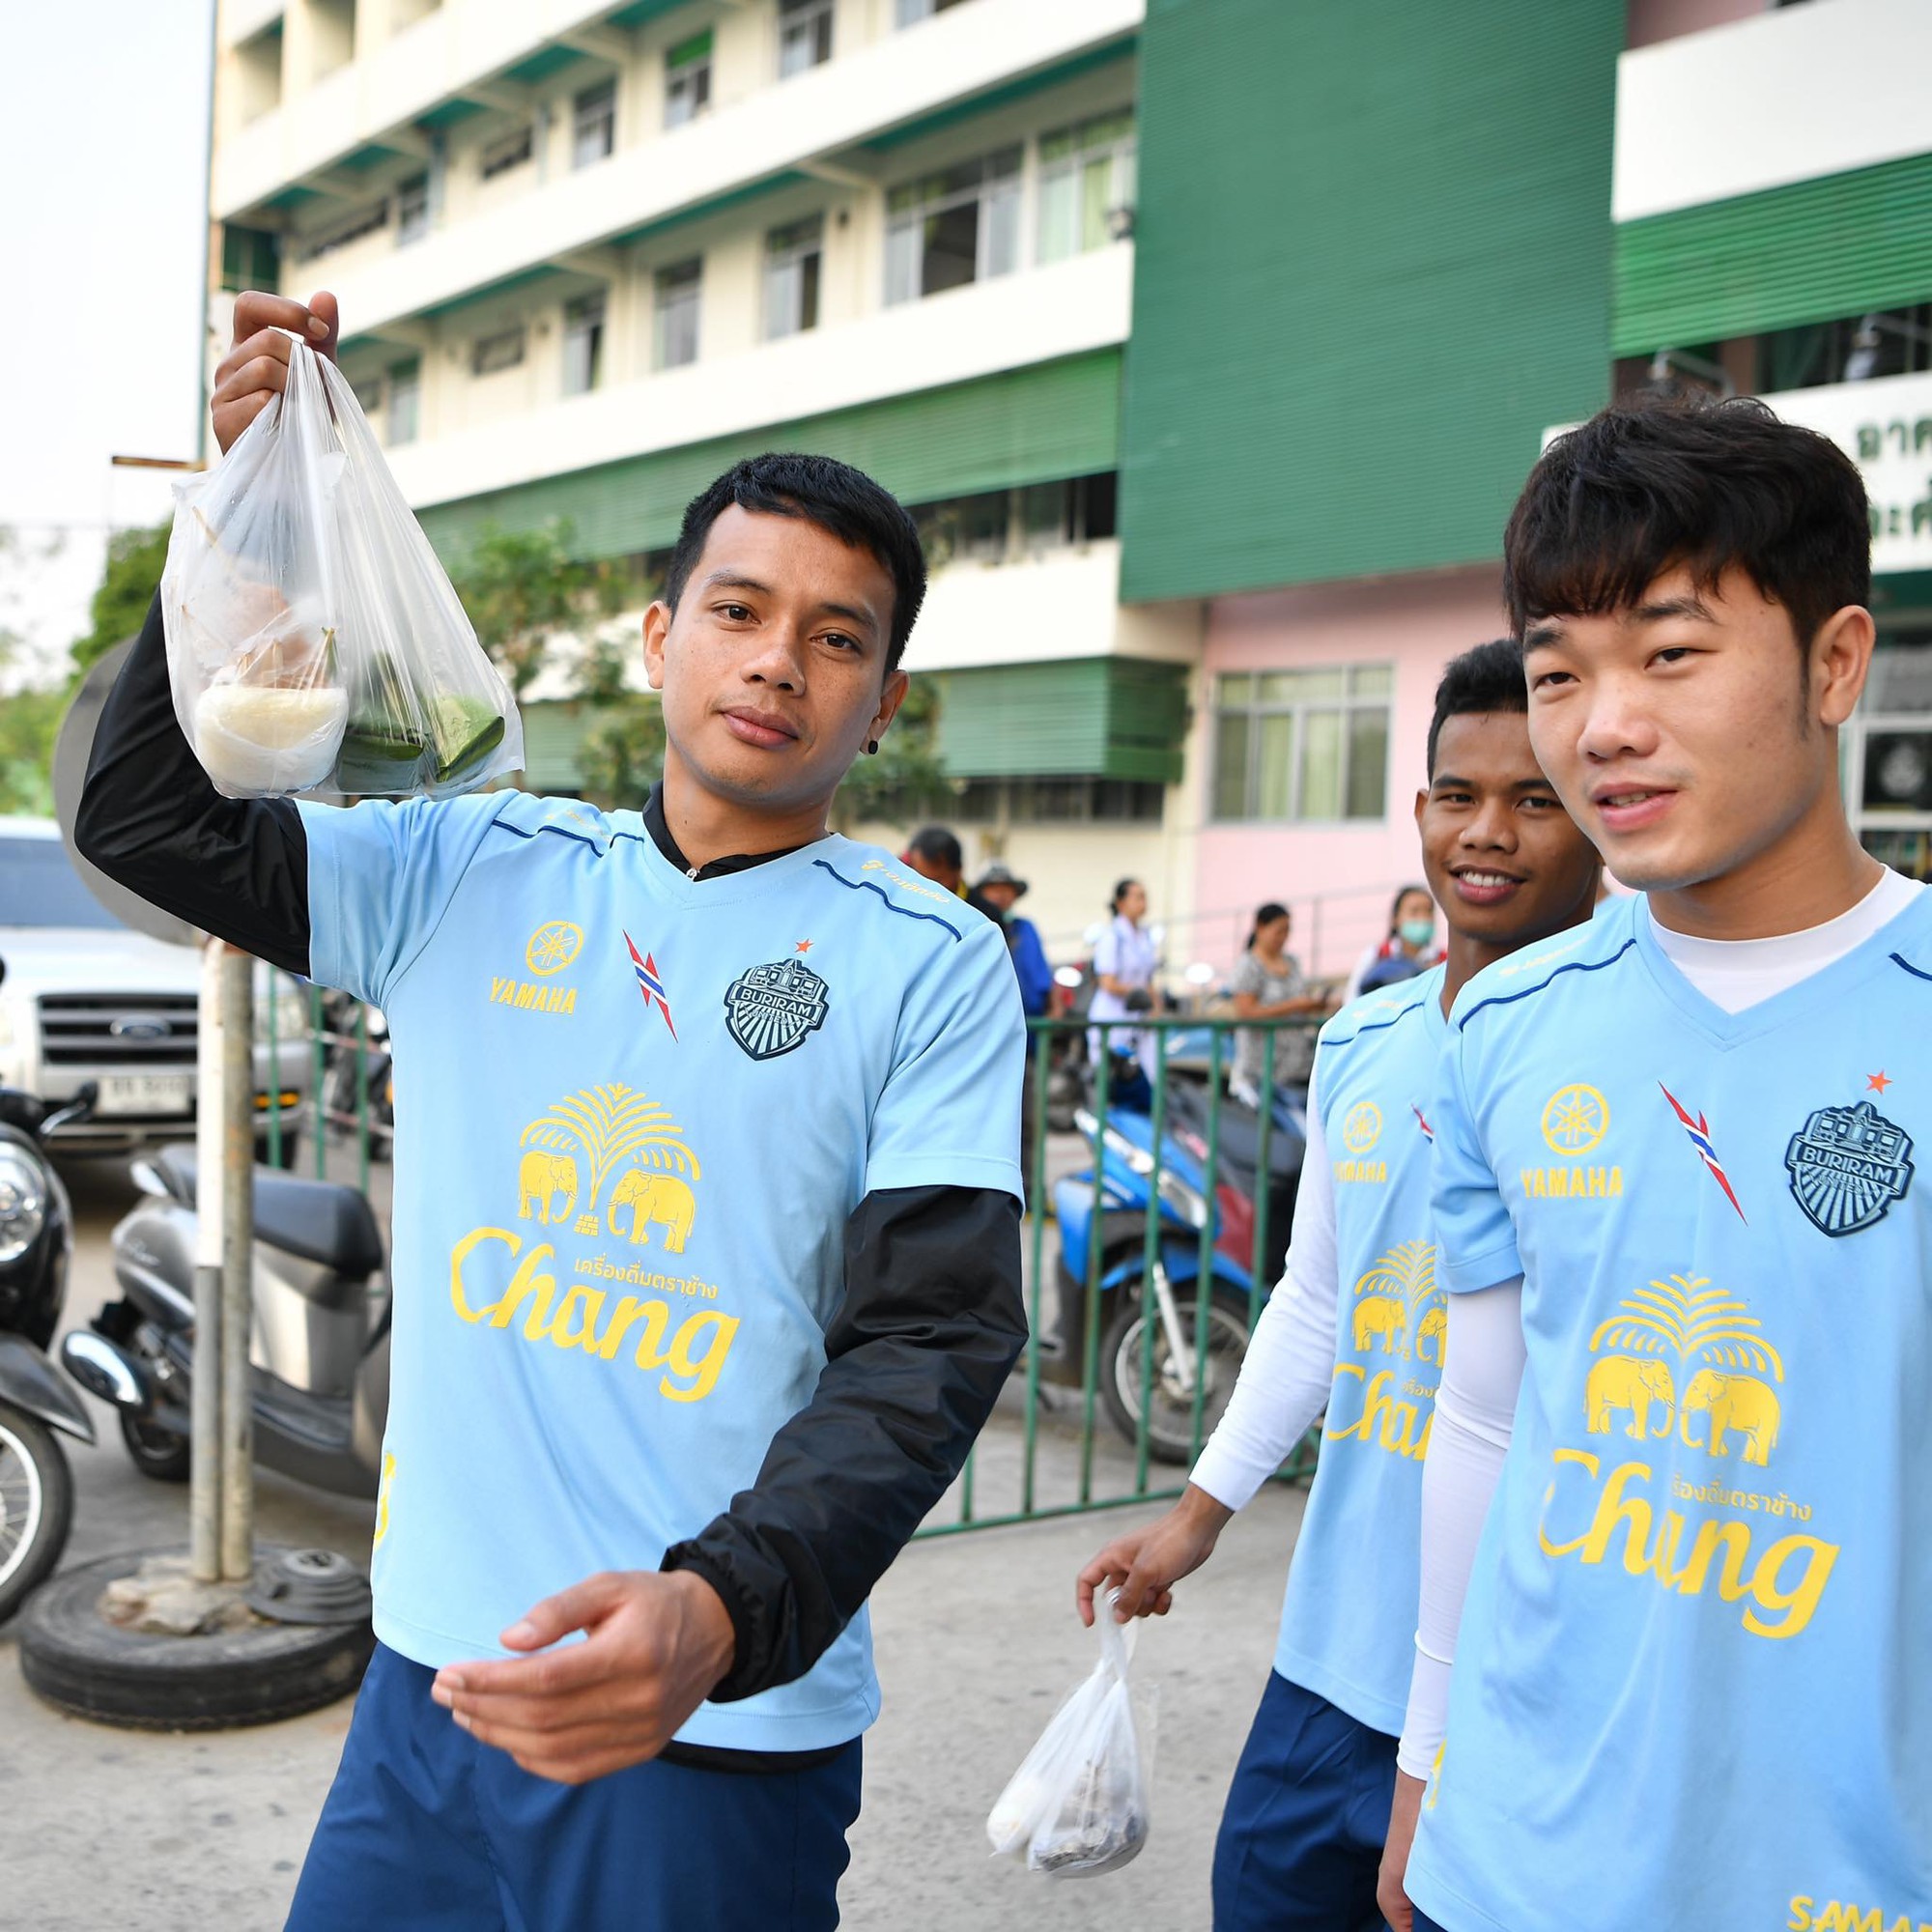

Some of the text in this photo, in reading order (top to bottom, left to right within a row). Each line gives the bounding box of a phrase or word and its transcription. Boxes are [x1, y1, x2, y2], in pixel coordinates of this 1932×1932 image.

[490, 977, 578, 1014] YAMAHA
[741, 988, 812, 1017] BURIRAM
[1803, 1146, 1892, 1182] BURIRAM
[1521, 1166, 1623, 1199] YAMAHA
[450, 1227, 741, 1402] Chang
[1539, 1448, 1841, 1639] Chang
